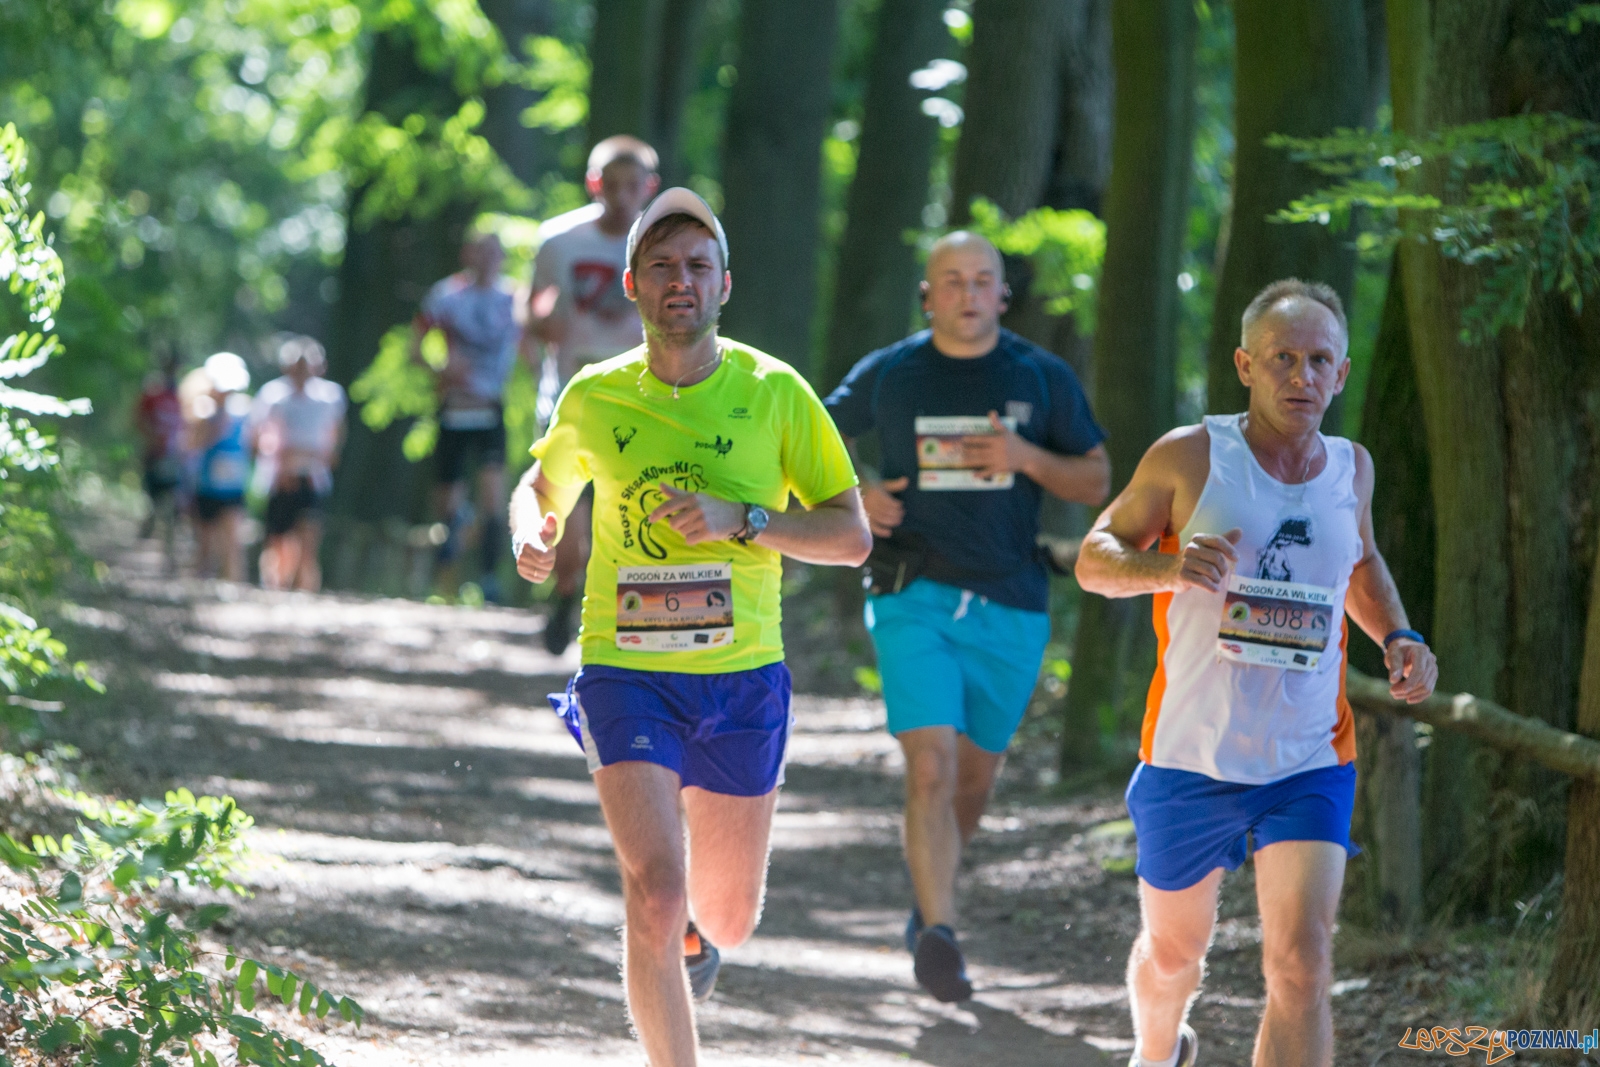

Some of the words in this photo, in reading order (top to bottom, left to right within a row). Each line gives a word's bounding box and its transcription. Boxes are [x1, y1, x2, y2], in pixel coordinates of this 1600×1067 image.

[663, 571, 677, 581] ZA
[679, 569, 723, 580] WILKIEM
[665, 589, 680, 612] 6
[1276, 587, 1289, 597] ZA
[1291, 590, 1328, 602] WILKIEM
[1257, 604, 1303, 630] 308
